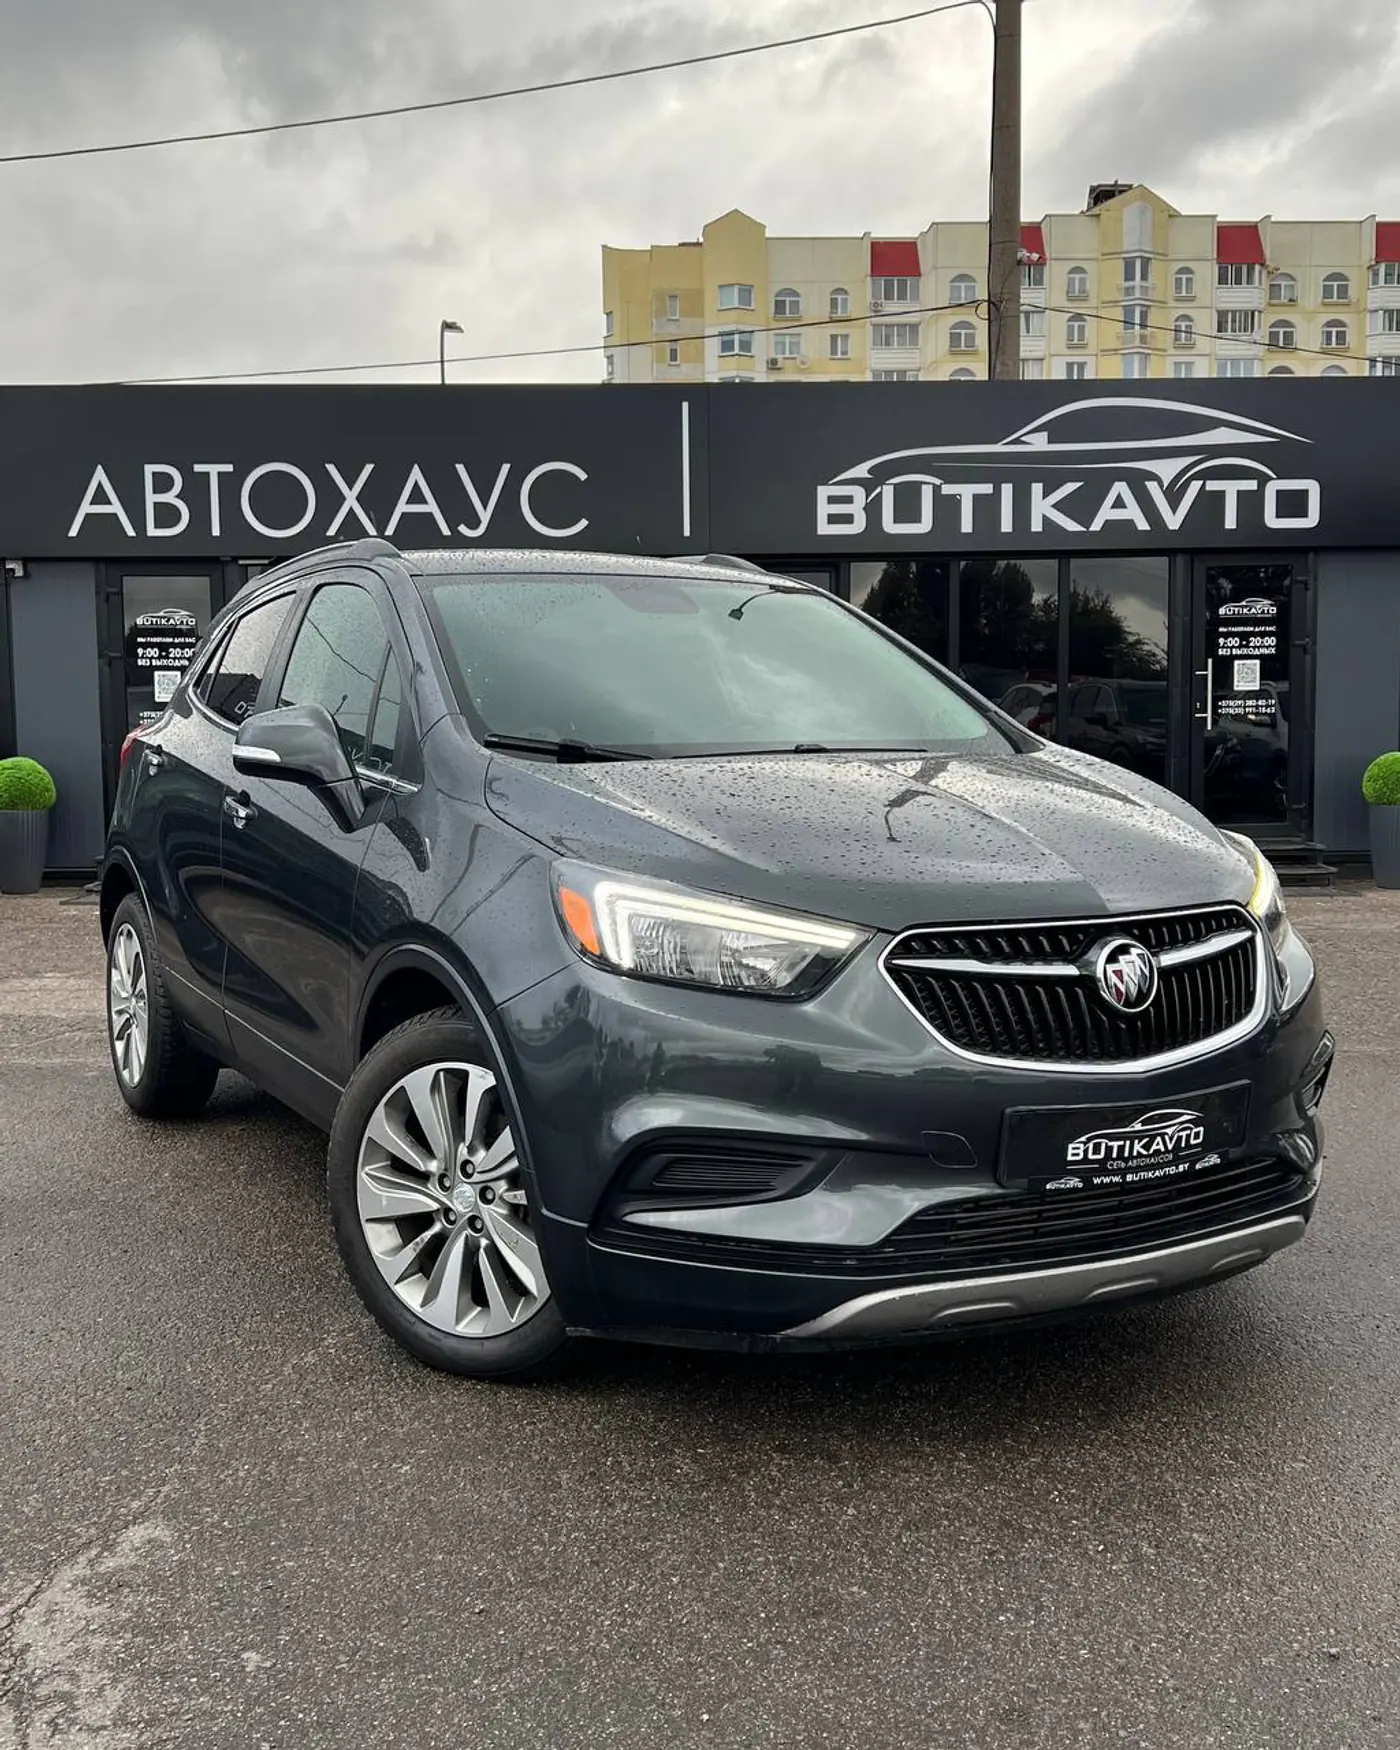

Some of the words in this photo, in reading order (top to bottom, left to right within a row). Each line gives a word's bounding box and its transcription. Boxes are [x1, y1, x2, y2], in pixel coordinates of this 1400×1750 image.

[67, 461, 590, 538] АВТОХАУС
[816, 478, 1321, 535] BUTIKAVTO
[1218, 606, 1277, 615] BUTIKAVTO
[136, 617, 196, 625] BUTIKAVTO
[1218, 637, 1240, 647] 9:00
[1248, 636, 1277, 647] 20:00
[136, 647, 159, 658] 9:00
[1218, 647, 1231, 656] БЕЗ
[1232, 647, 1276, 655] ВЫХОДНЫХ
[136, 658, 150, 666] БЕЗ
[1066, 1126, 1205, 1161] BUTIKAVTO
[1092, 1175, 1123, 1185] WWW.
[1125, 1162, 1190, 1182] BUTIKAVTO.BY
